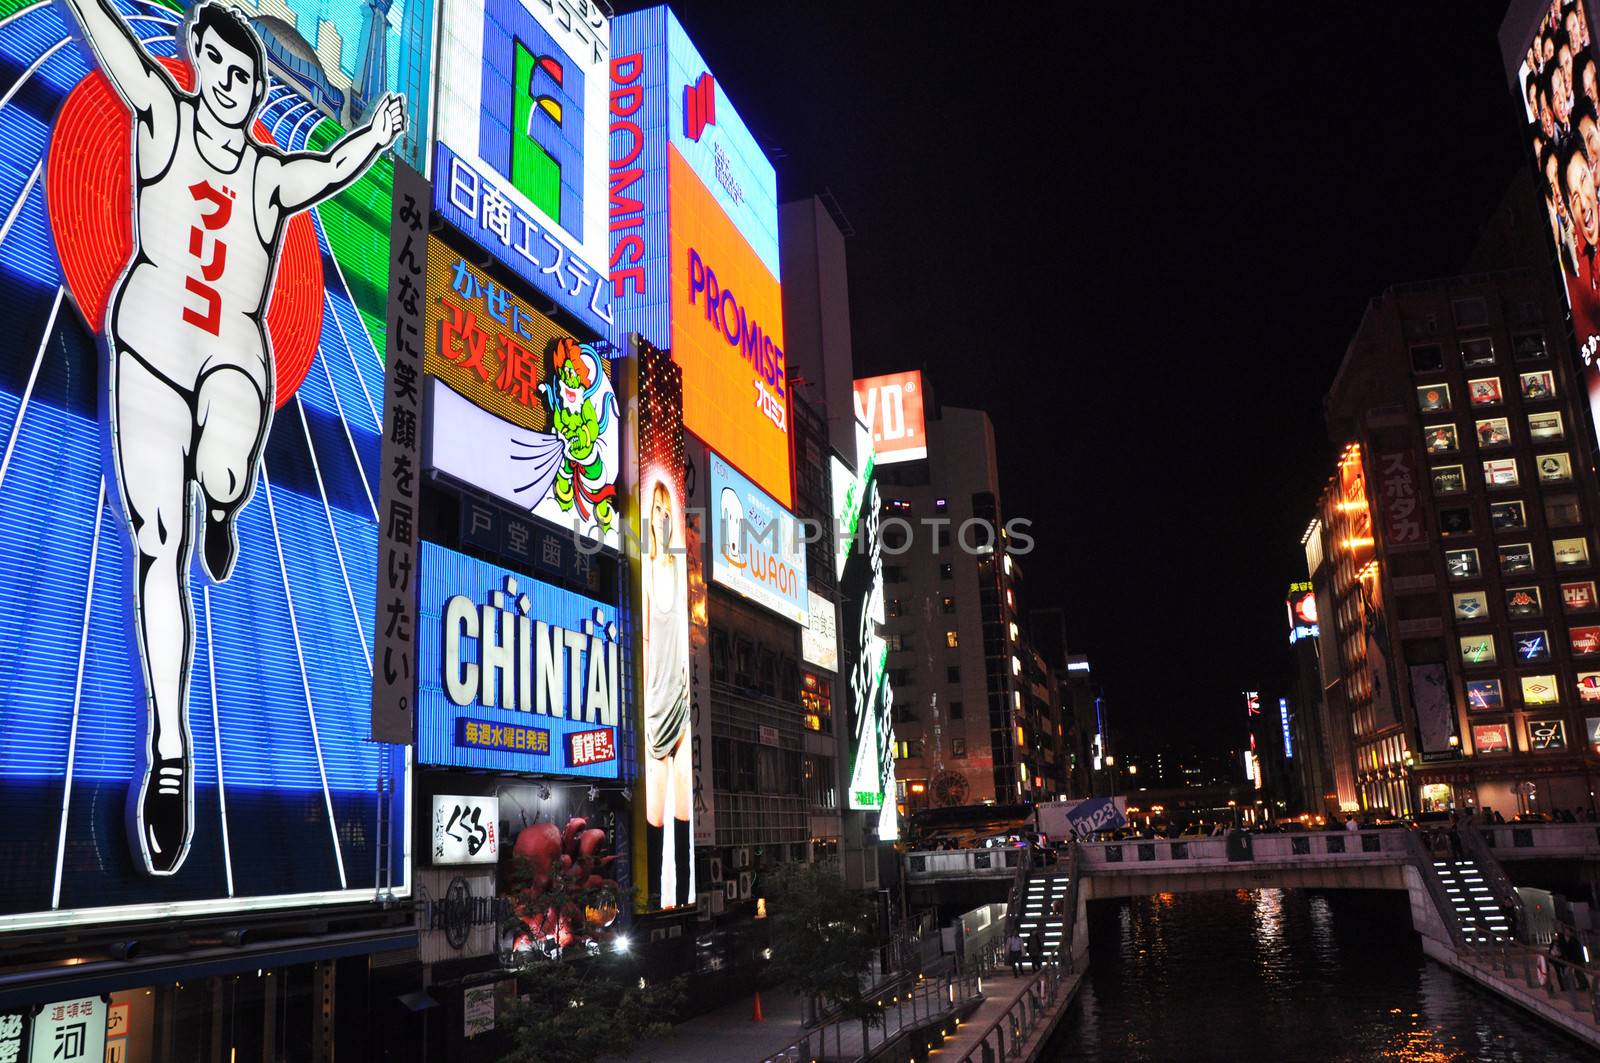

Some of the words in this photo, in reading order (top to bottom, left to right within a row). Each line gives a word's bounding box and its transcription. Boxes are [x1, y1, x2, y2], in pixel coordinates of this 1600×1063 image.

[182, 180, 236, 337] グリコ
[451, 156, 613, 325] 日商エステム
[451, 258, 535, 340] かぜに
[688, 247, 785, 398] PROMISE
[437, 297, 541, 408] 改源
[382, 192, 422, 712] みんなに笑顔を届けたい。
[1381, 452, 1421, 542] スポタカ
[749, 543, 798, 600] WAON
[444, 577, 619, 726] CHINTAI
[465, 721, 549, 752] 毎週水曜日発売
[571, 734, 595, 764] 賃貸
[445, 804, 487, 856] くくる
[1077, 802, 1117, 838] 0123
